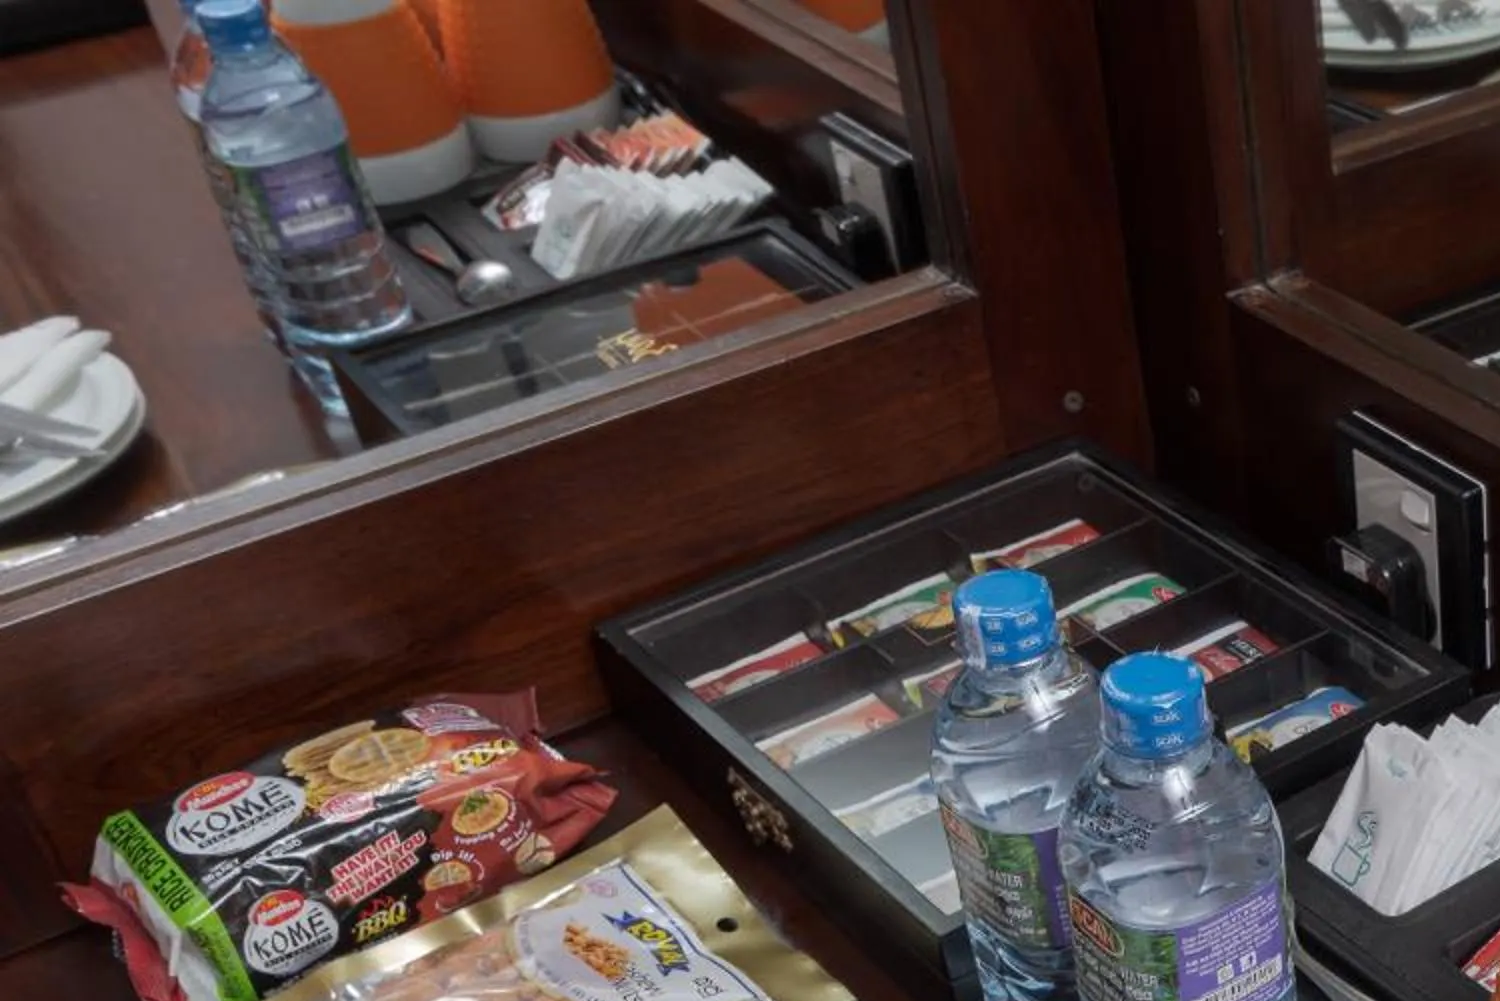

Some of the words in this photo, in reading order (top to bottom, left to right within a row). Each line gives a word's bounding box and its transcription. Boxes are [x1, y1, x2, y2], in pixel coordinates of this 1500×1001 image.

[180, 780, 293, 843] KOME
[106, 816, 169, 880] CRACKER
[334, 845, 376, 878] HAVE
[152, 867, 196, 913] RICE
[328, 878, 355, 902] THE
[352, 872, 394, 899] WANT
[252, 906, 331, 961] KOME
